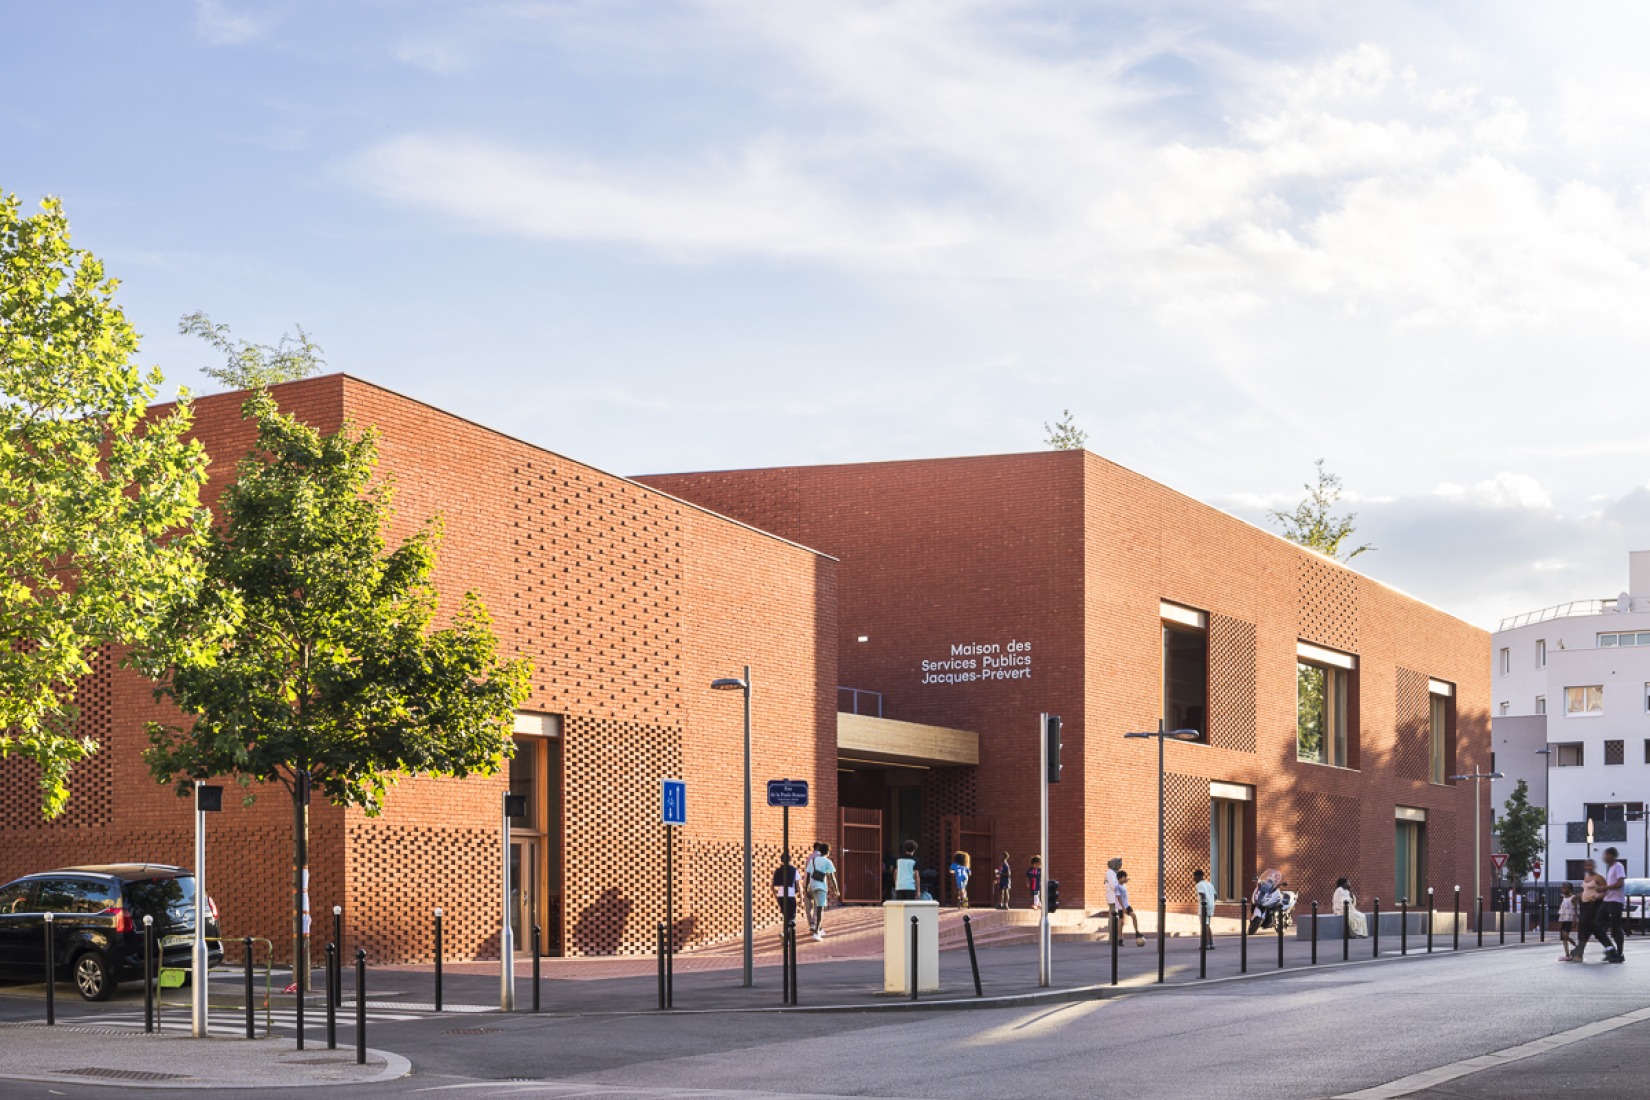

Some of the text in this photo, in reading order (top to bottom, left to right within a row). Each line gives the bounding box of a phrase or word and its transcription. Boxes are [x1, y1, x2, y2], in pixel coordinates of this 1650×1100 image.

[950, 639, 1032, 656] Maison des
[921, 653, 1031, 671] Services Publics
[921, 667, 1031, 684] Jacques-Prévert
